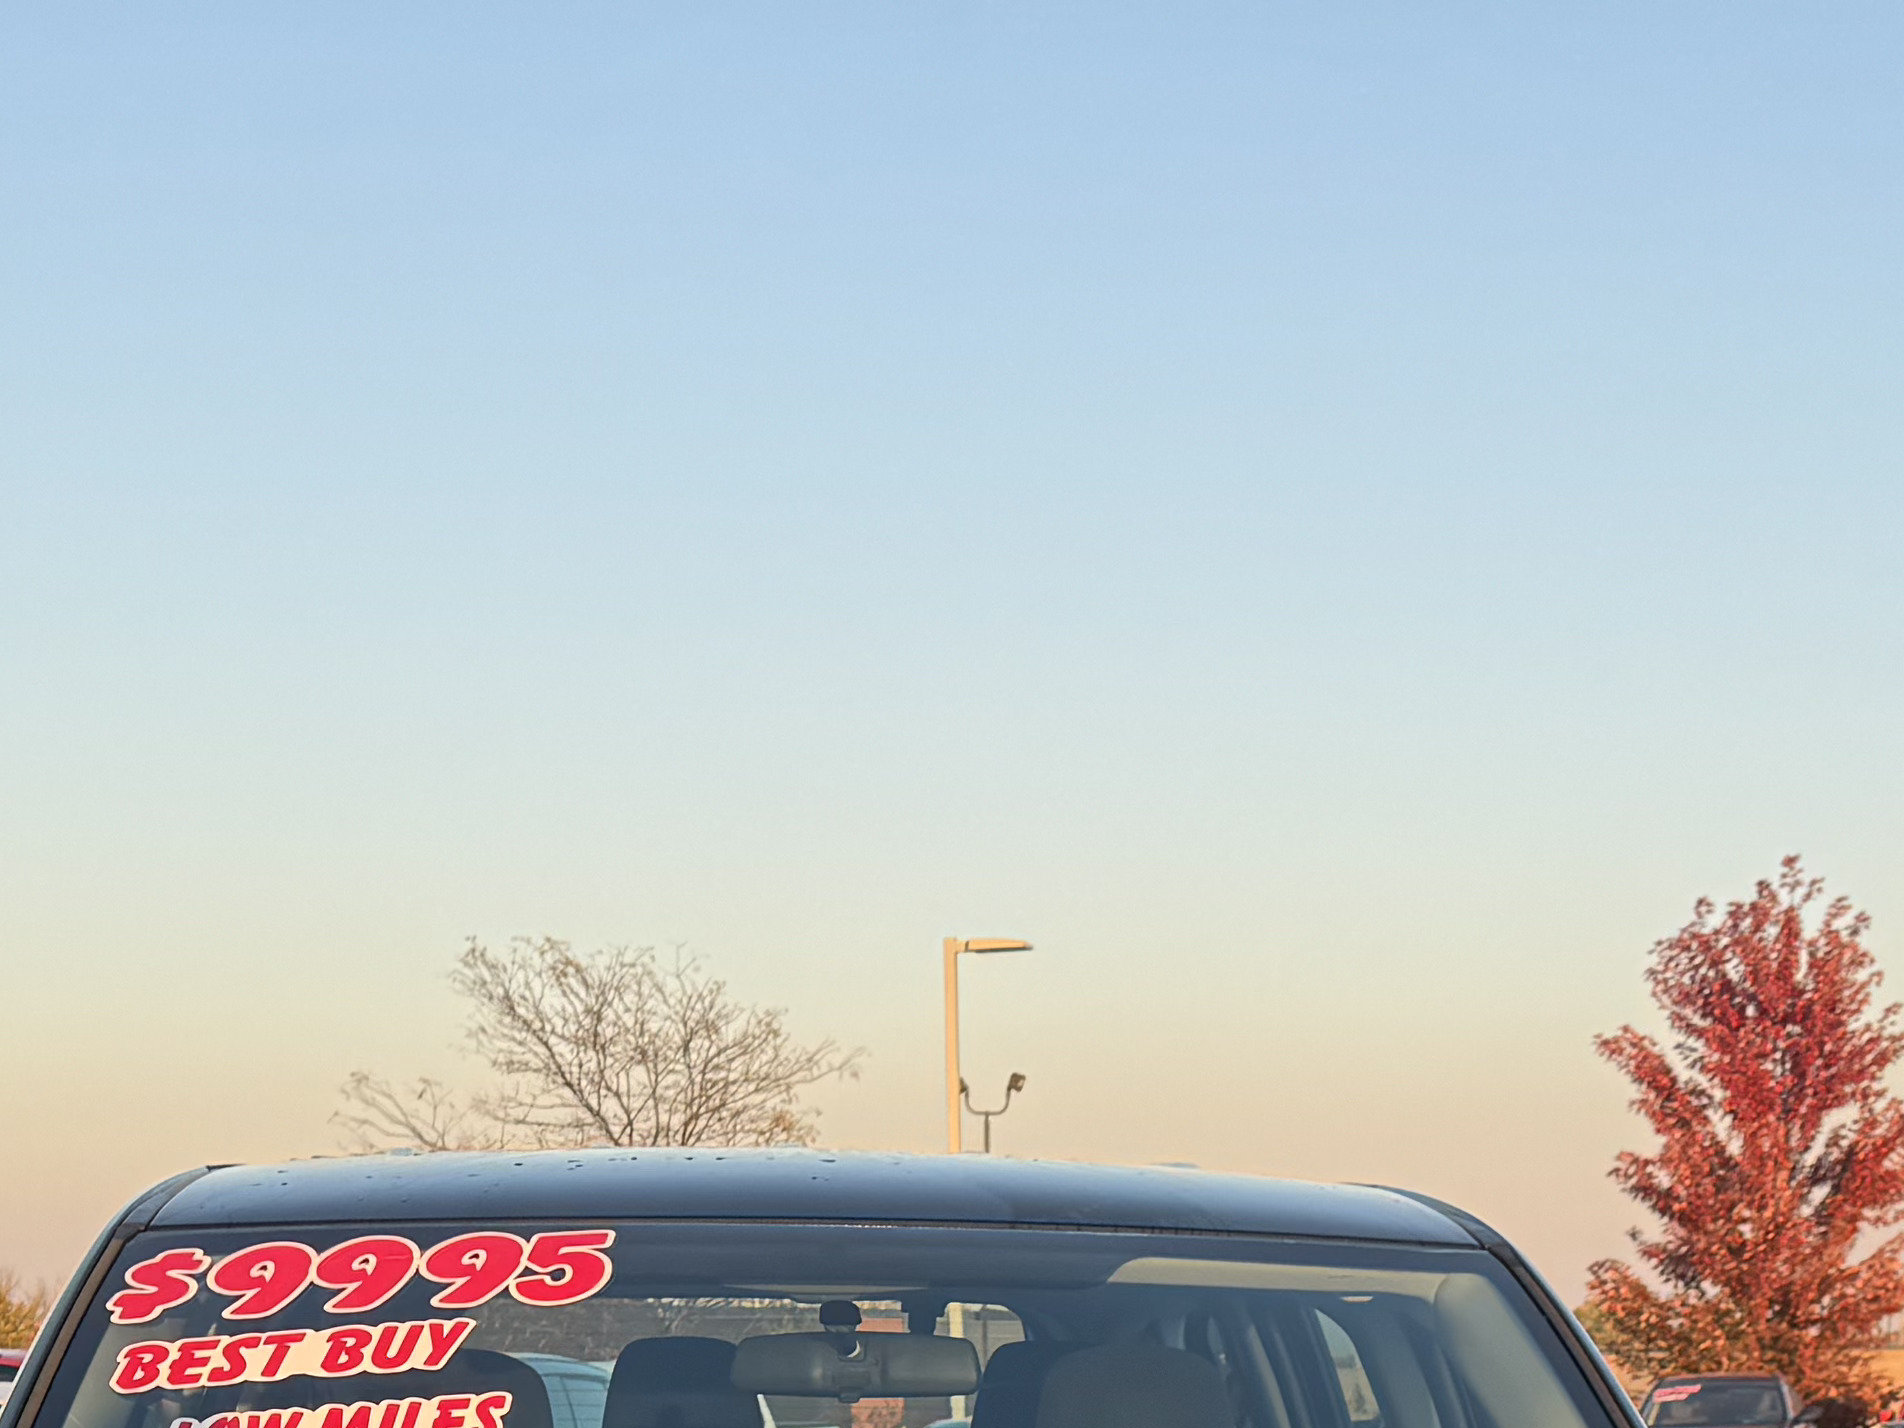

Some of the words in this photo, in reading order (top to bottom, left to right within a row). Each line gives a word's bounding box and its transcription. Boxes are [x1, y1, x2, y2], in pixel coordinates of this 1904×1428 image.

[106, 1230, 615, 1324] $9995
[115, 1331, 306, 1390] BEST
[319, 1320, 474, 1373] BUY
